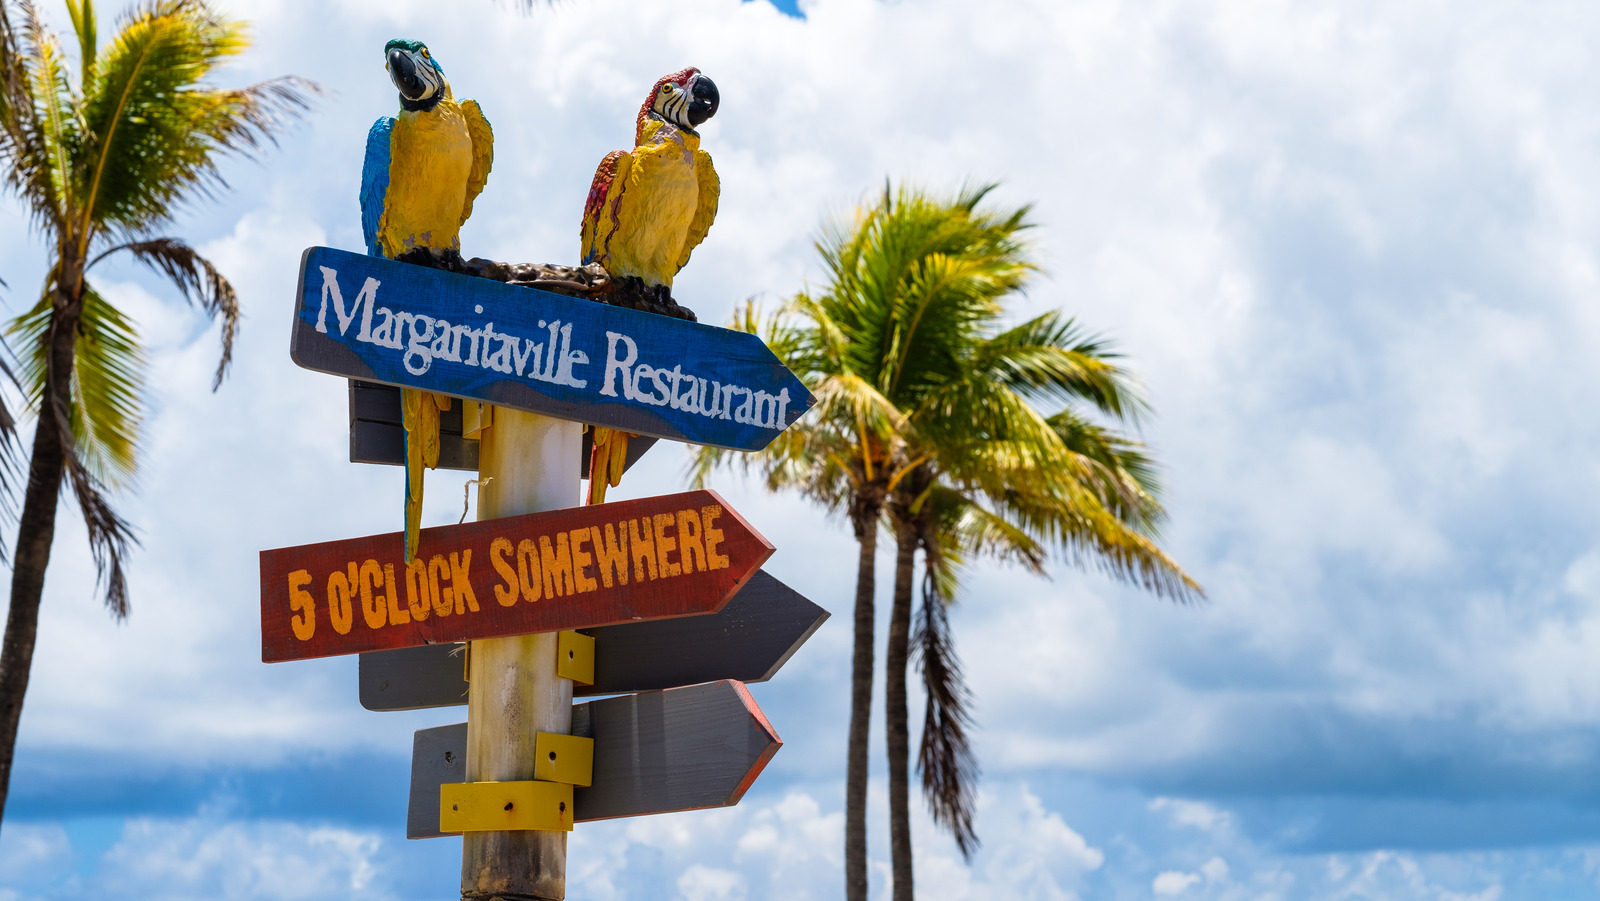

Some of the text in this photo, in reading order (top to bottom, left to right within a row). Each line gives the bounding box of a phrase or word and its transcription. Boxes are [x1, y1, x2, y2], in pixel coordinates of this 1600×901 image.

[315, 265, 792, 431] Margaritaville Restaurant
[288, 504, 730, 641] 5 O'CLOCK SOMEWHERE
